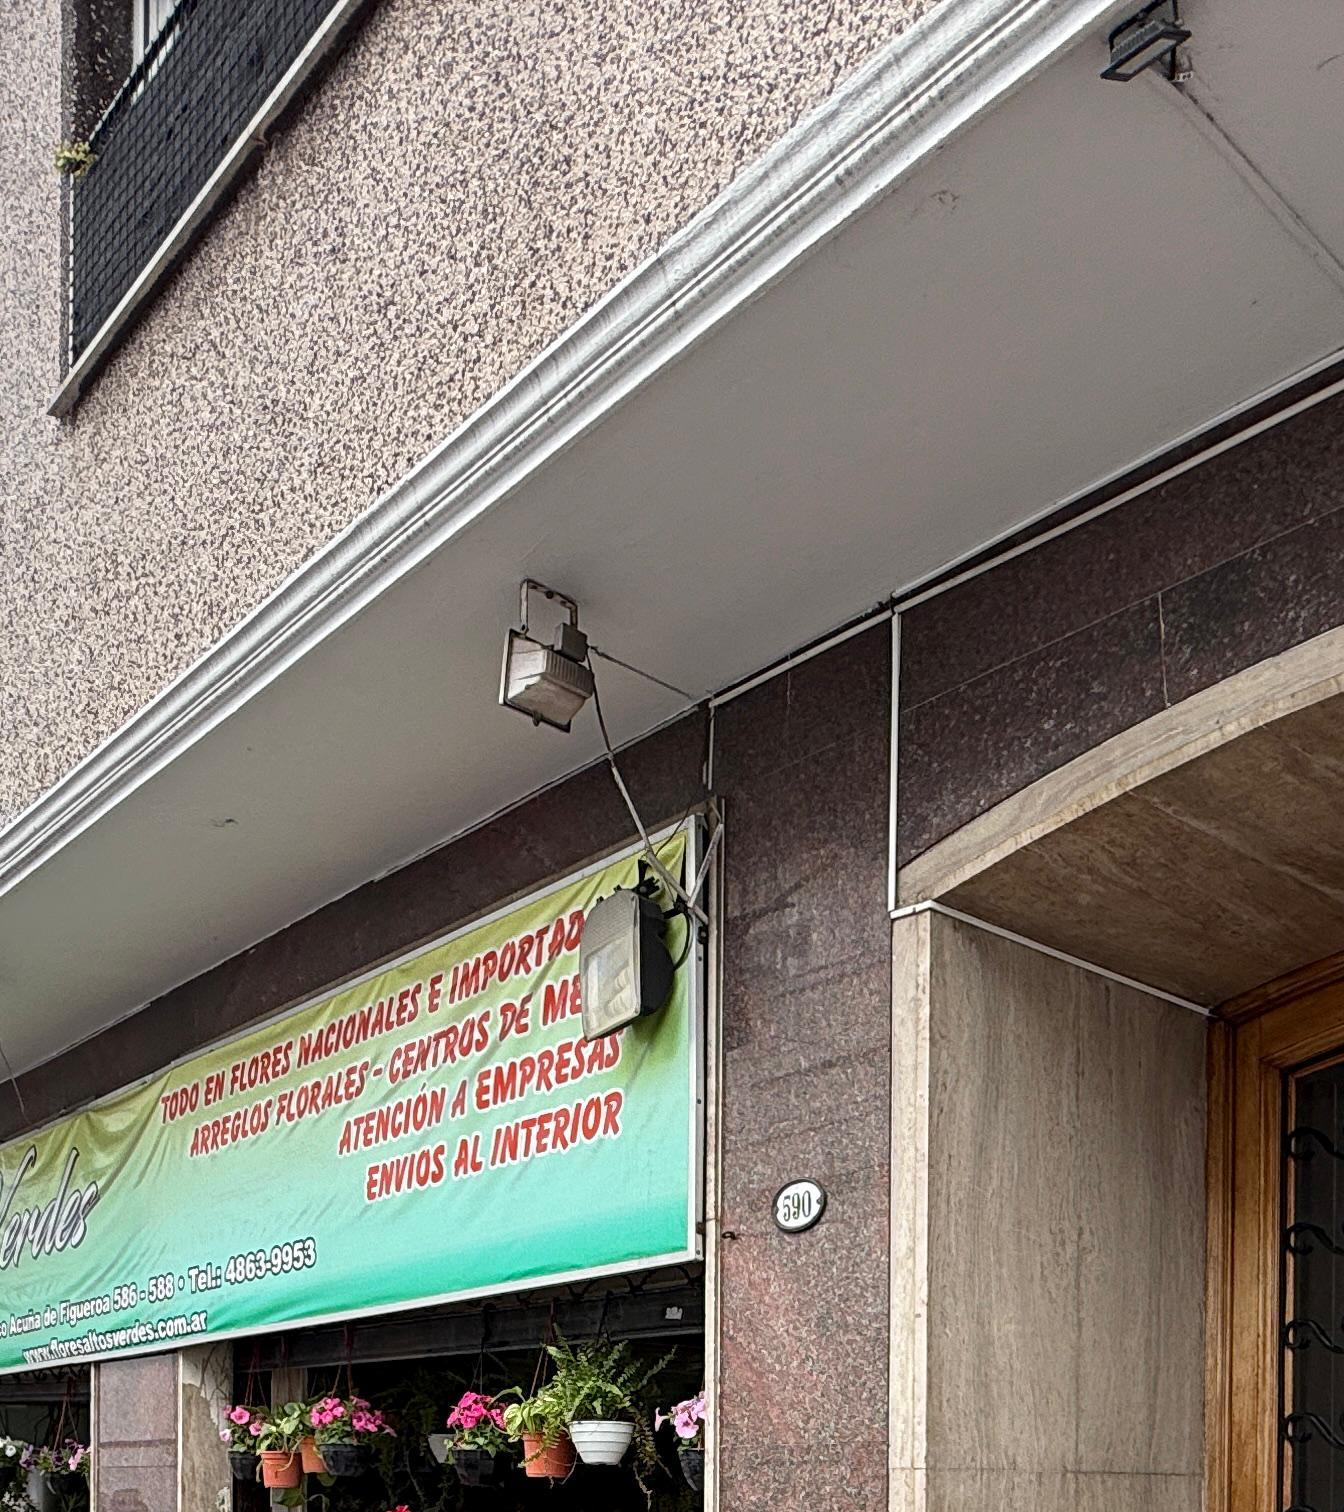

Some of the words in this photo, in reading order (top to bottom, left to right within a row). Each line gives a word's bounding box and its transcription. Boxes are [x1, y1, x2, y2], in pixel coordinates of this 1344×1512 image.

[161, 1083, 198, 1123] TODO
[205, 1071, 226, 1105] EN
[230, 1041, 293, 1095] FLORES
[297, 983, 422, 1068] NACIONALES
[428, 974, 443, 1013] E
[449, 910, 584, 1004] IMPORTAD
[190, 1099, 272, 1157] ARREGLOS
[275, 1061, 369, 1126] FLORALES
[388, 1011, 490, 1084] CENTROS
[499, 992, 534, 1042] DE
[542, 973, 582, 1026] ME
[339, 1082, 446, 1155] ATENCIÓN
[451, 1080, 467, 1118] A
[476, 1030, 623, 1110] EMPRESAS
[367, 1144, 445, 1200] ENVIOS
[454, 1135, 483, 1177] AL
[490, 1092, 623, 1167] INTERIOR
[782, 1190, 812, 1222] 590
[9, 1309, 41, 1336] Acuña
[43, 1304, 57, 1328] de
[59, 1294, 111, 1327] Figueroa
[113, 1282, 138, 1311] 586
[148, 1272, 174, 1303] 588
[188, 1262, 221, 1294] Tel.:
[225, 1237, 316, 1285] 4863-9953
[22, 1310, 207, 1364] www.floresaltosverdes.com.ar
